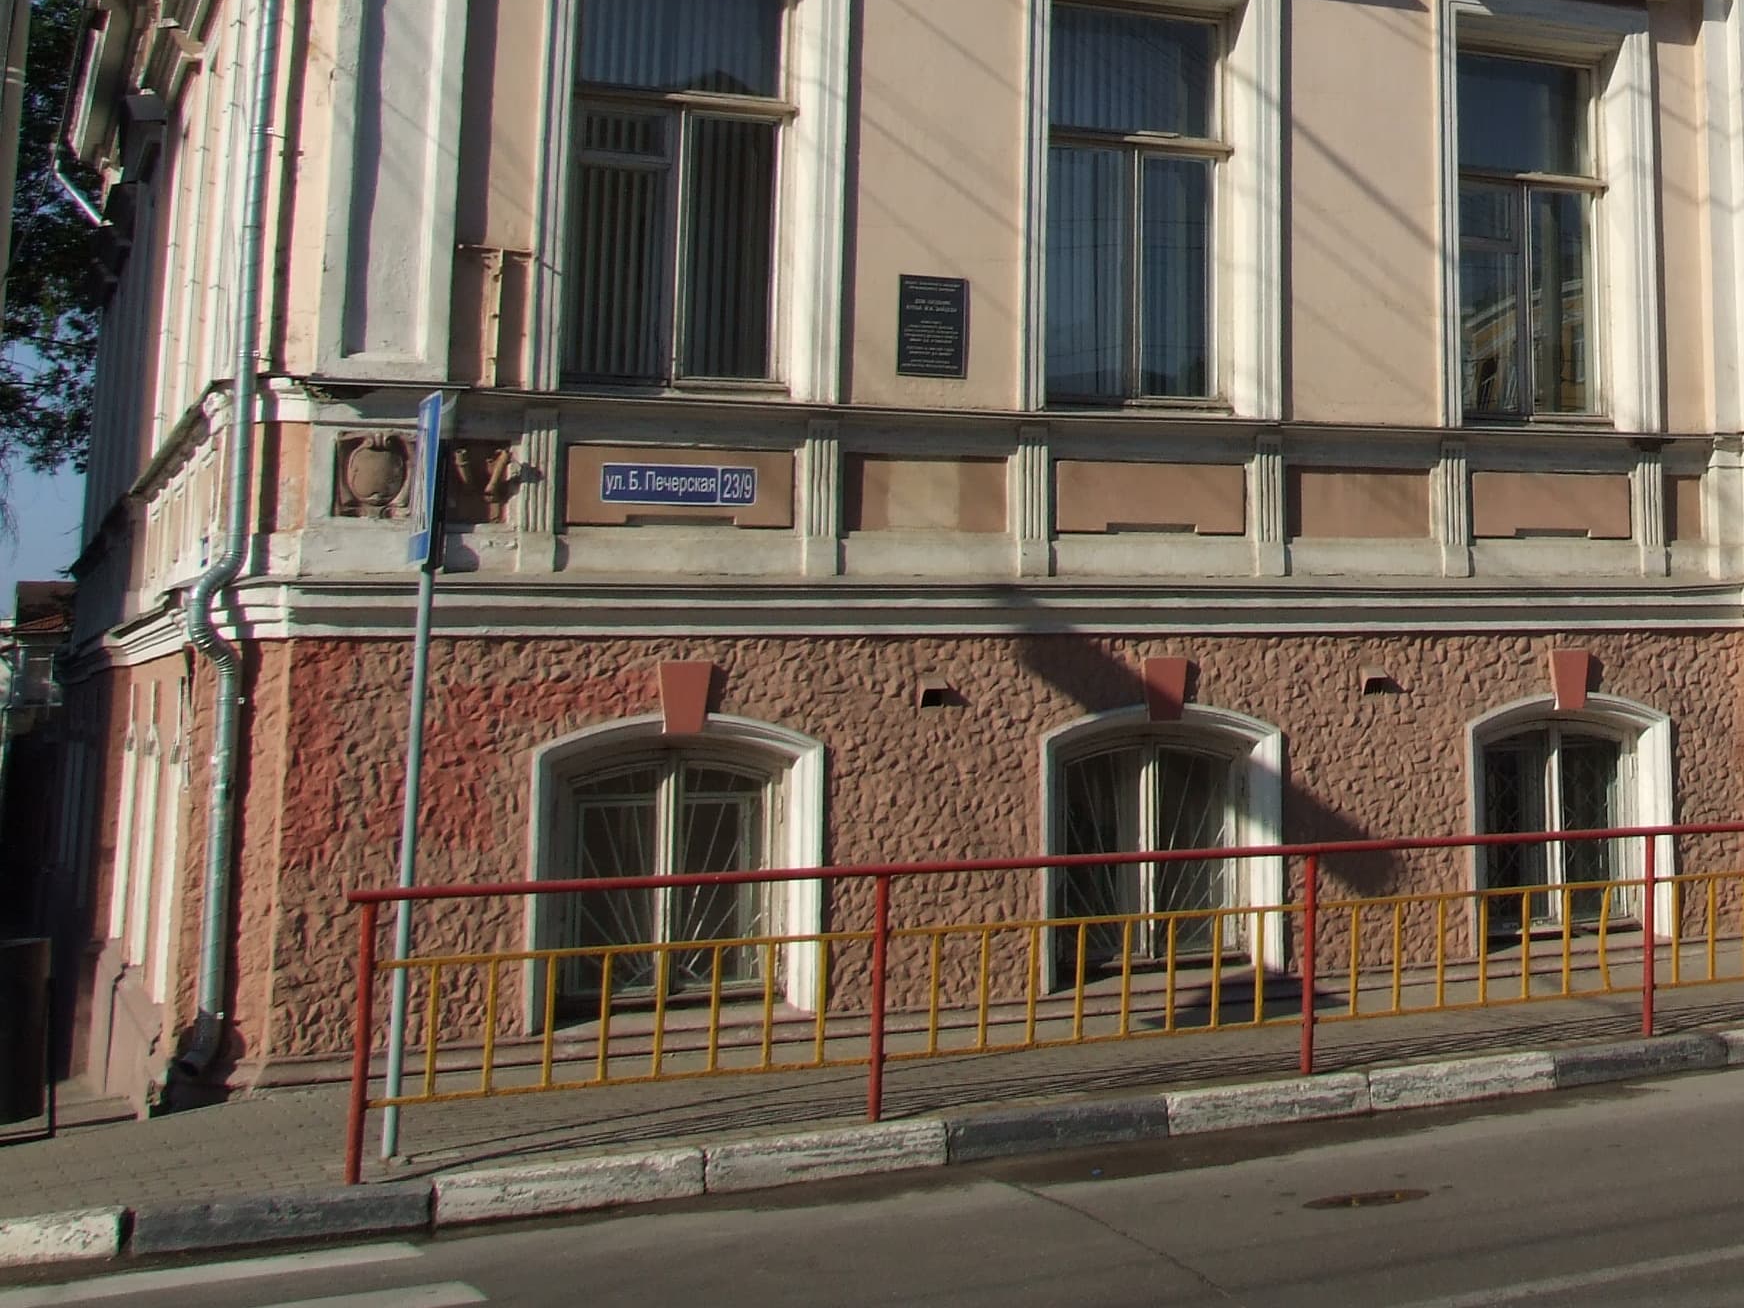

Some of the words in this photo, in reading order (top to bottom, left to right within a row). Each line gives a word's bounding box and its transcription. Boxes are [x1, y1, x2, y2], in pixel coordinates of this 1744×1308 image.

[605, 474, 625, 495] ул.
[629, 470, 642, 491] Б.
[645, 471, 716, 496] Печерская
[722, 473, 753, 499] 23/9
